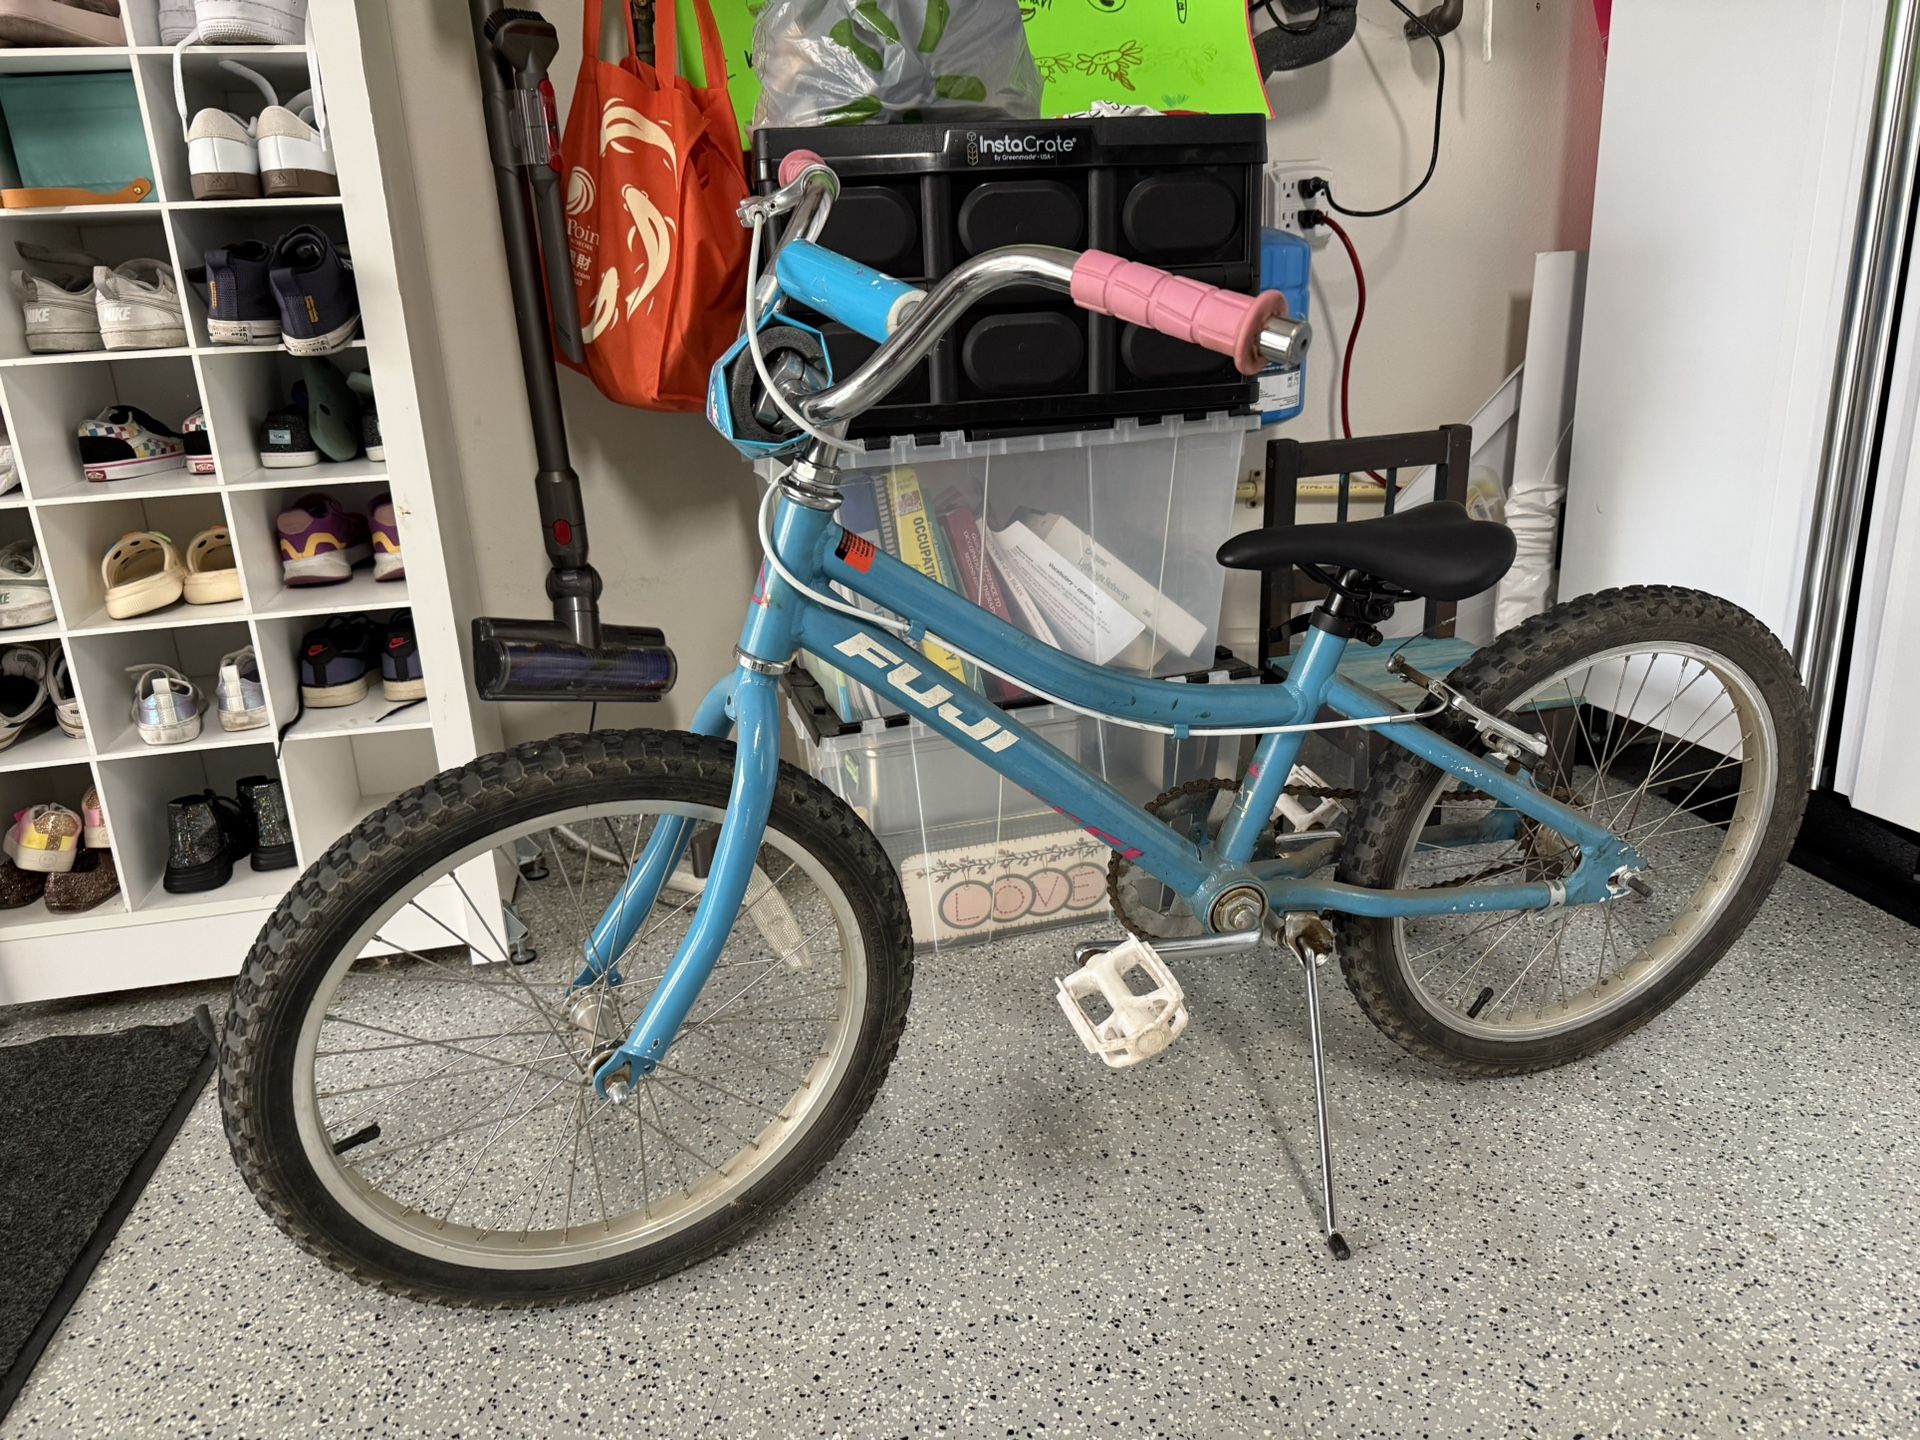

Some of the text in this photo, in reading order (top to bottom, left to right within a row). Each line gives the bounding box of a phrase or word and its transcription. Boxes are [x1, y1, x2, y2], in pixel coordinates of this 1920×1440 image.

[26, 308, 50, 323] NIKE
[103, 306, 131, 322] NIKE
[832, 631, 1021, 753] FUJI
[955, 870, 1097, 922] LOVE
